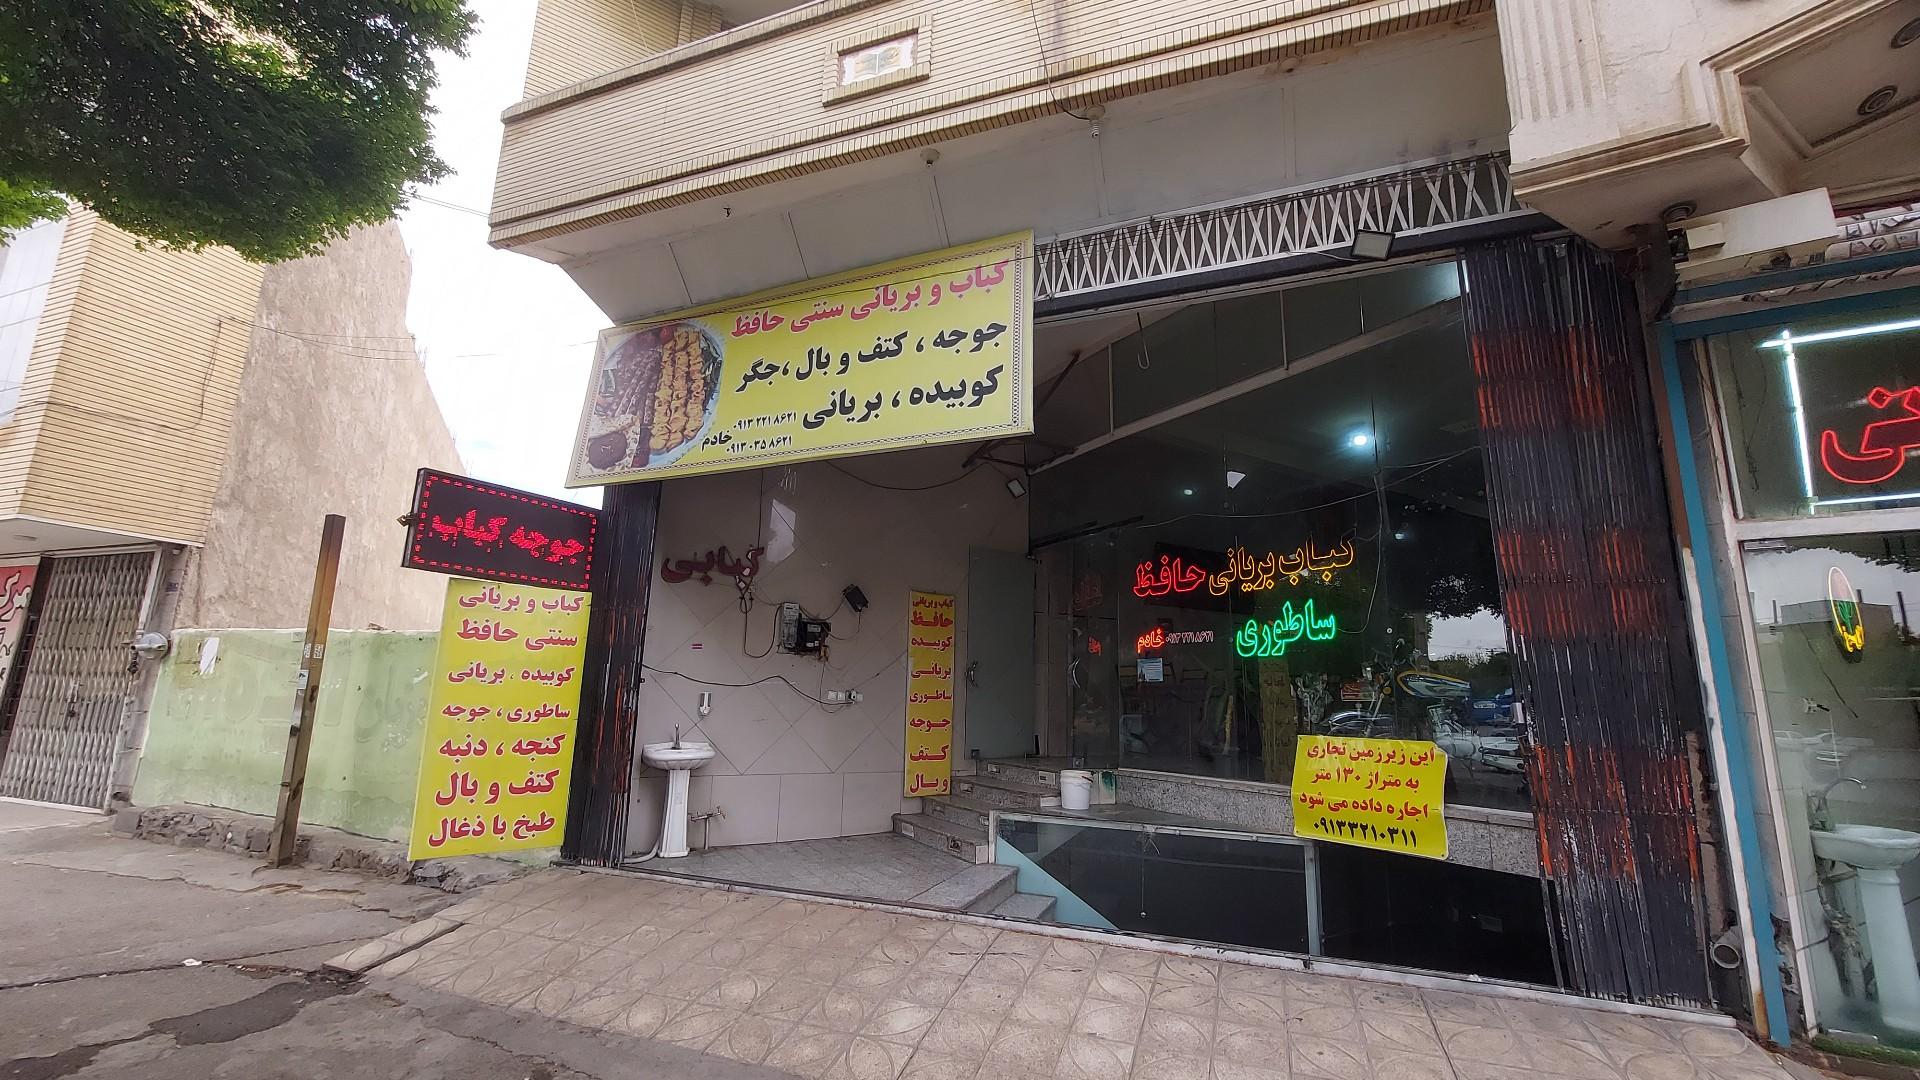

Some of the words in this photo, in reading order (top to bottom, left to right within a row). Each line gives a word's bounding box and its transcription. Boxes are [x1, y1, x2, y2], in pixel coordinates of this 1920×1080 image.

[949, 258, 1009, 295] کباب
[849, 284, 922, 321] بریانی
[928, 282, 943, 306] و
[731, 309, 785, 338] حافظ
[789, 301, 844, 333] سنتی
[856, 331, 908, 363] کتف
[932, 322, 1008, 351] جوجه
[796, 348, 832, 381] بال
[835, 353, 850, 375] و
[908, 364, 1005, 408] کوبیده
[802, 388, 884, 430] بریانی
[701, 430, 733, 452] خادم
[428, 508, 509, 553] کباب
[508, 526, 586, 566] جوجه
[1209, 546, 1276, 596] بریانی
[1278, 534, 1355, 584] کباب
[1132, 555, 1206, 598] حافظ
[458, 586, 521, 612] بریانی
[525, 597, 537, 613] و
[541, 594, 584, 616] کباب
[456, 618, 520, 643] حافظ
[911, 610, 954, 628] حافظ
[1236, 598, 1337, 657] ساطوری
[525, 628, 578, 651] سنتی
[911, 635, 953, 651] کوبیده
[447, 661, 506, 685] بریانی
[521, 666, 576, 687] کوبیده
[910, 662, 952, 680] بریانی
[909, 689, 953, 704] ساطوری
[441, 703, 492, 723] جوجه
[506, 703, 571, 723] ساطوری
[909, 717, 951, 733] جوجه
[438, 733, 489, 764] دنبه
[510, 733, 567, 762] کنجه
[909, 745, 950, 762] کتف
[1306, 741, 1347, 760] تجاری
[1408, 747, 1436, 767] این
[507, 768, 561, 796] کتف
[909, 773, 940, 794] بال
[942, 777, 949, 793] و
[1310, 768, 1332, 785] متر
[1336, 766, 1362, 784] ۱۳۰
[1364, 770, 1402, 791] متراژ
[1404, 779, 1420, 794] به
[434, 771, 479, 807] بال
[483, 780, 501, 804] و
[1299, 790, 1325, 810] شود
[1327, 798, 1349, 812] می
[1351, 797, 1383, 813] داده
[1386, 800, 1429, 823] اجاره
[427, 815, 487, 848] ذغال
[491, 814, 508, 841] با
[511, 810, 556, 841] طبخ
[1313, 816, 1418, 848] ۰۹۱۳۳۲۱۰۳۱۱
